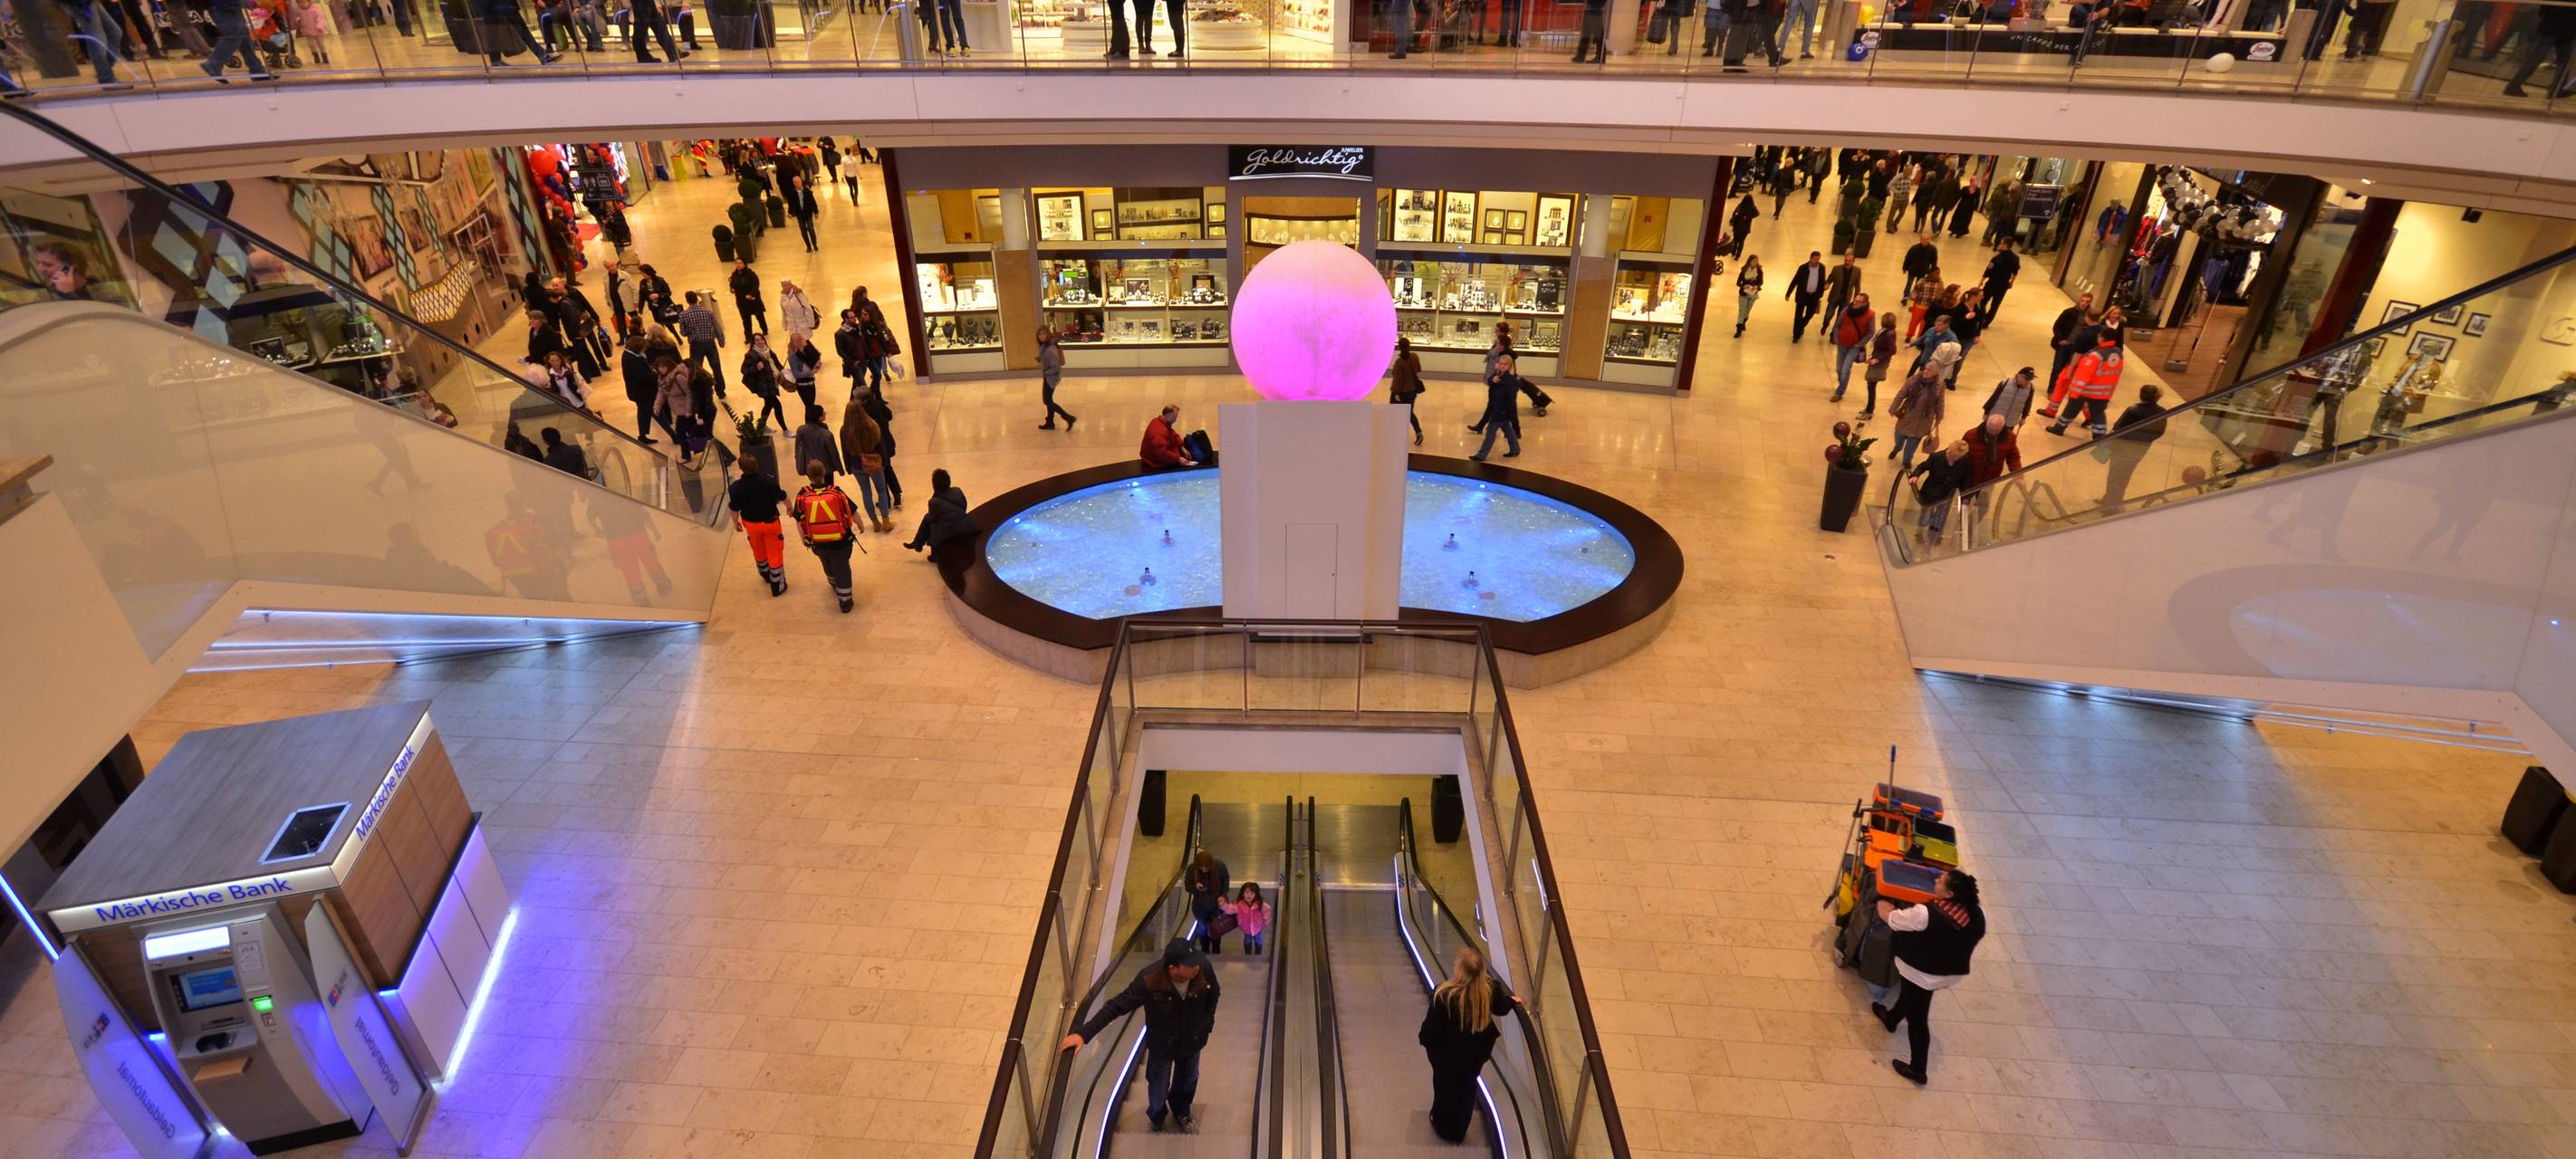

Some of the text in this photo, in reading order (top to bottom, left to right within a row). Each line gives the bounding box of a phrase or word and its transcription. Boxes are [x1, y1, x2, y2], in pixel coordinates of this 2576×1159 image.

[1242, 148, 1361, 175] Goldrichtig
[355, 745, 415, 841] Märkische Bank
[95, 877, 293, 923] Märkische Bank
[355, 1016, 399, 1096] Geldautomat
